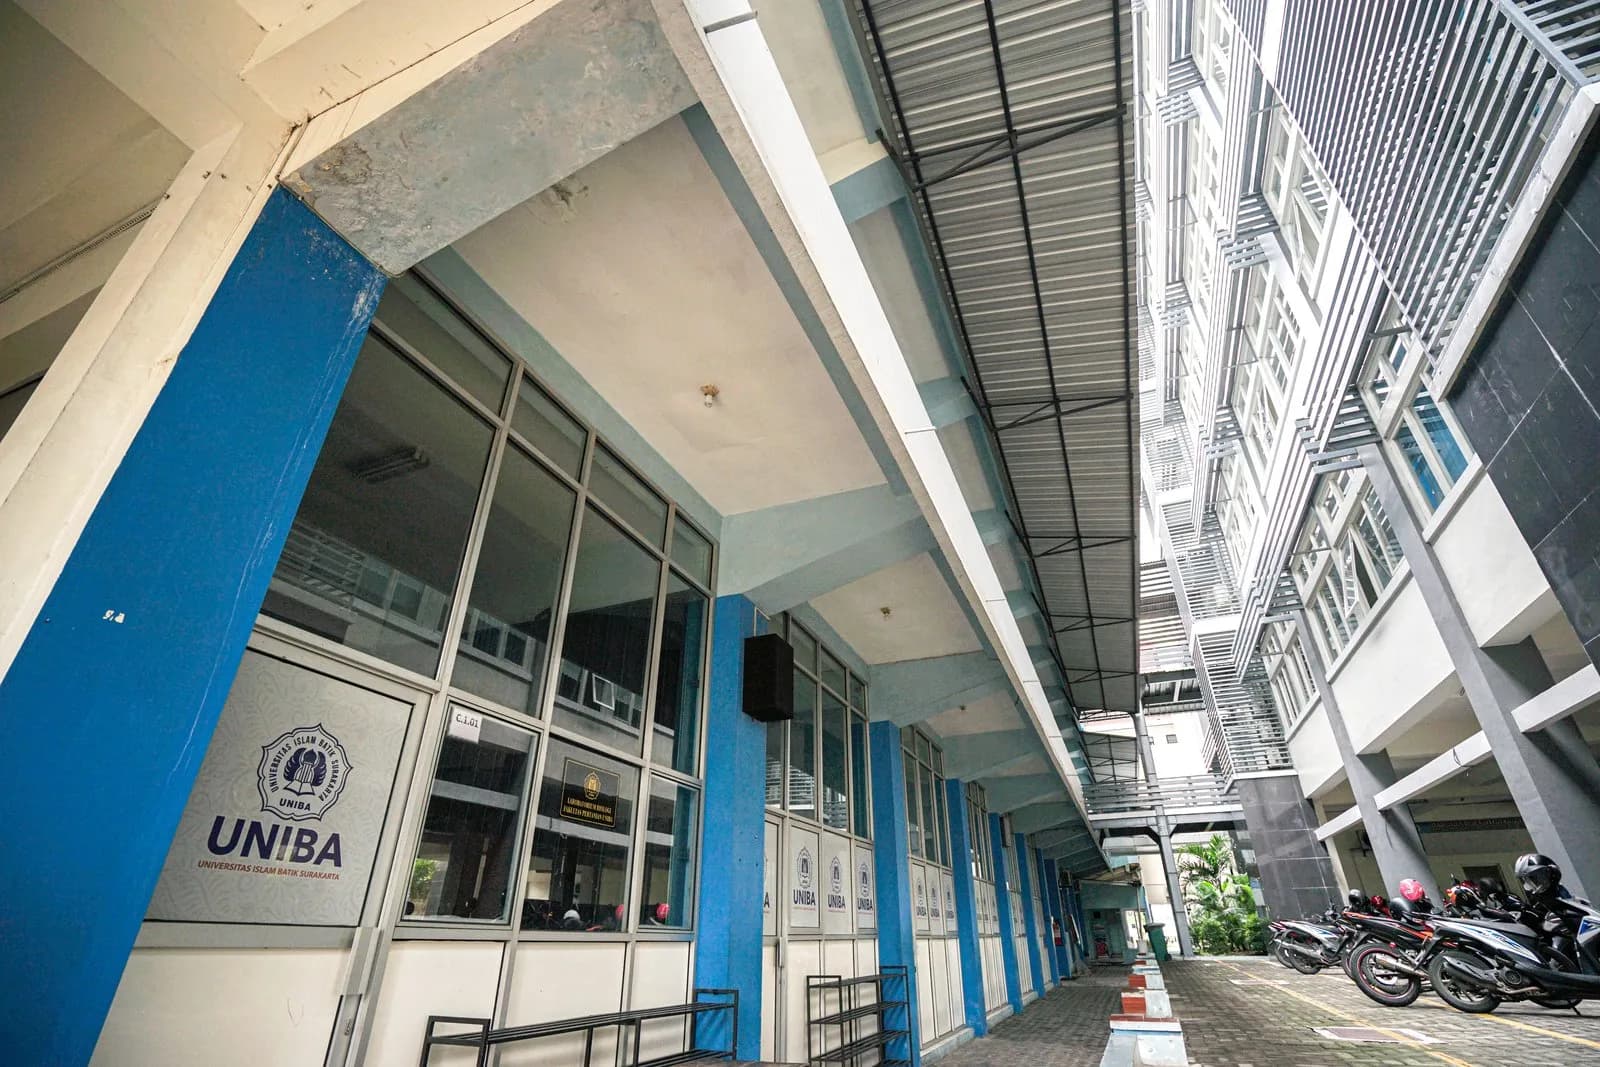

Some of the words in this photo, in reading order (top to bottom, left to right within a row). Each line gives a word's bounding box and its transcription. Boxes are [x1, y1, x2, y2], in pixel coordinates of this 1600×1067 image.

[293, 735, 317, 747] ISLAM
[318, 739, 337, 758] BATIK
[268, 743, 292, 793] UNIVERSITAS
[318, 759, 339, 802] SURAKARTA
[279, 798, 311, 811] UNIBA
[208, 815, 342, 868] UNIBA
[198, 860, 251, 872] UNIVERSITAS
[252, 864, 277, 875] ISLAM
[277, 867, 299, 877] BATIK
[299, 870, 340, 881] SURAKARTA
[793, 889, 816, 906] UNIBA
[828, 894, 846, 909] UNIBA
[857, 897, 873, 911] UNIBA
